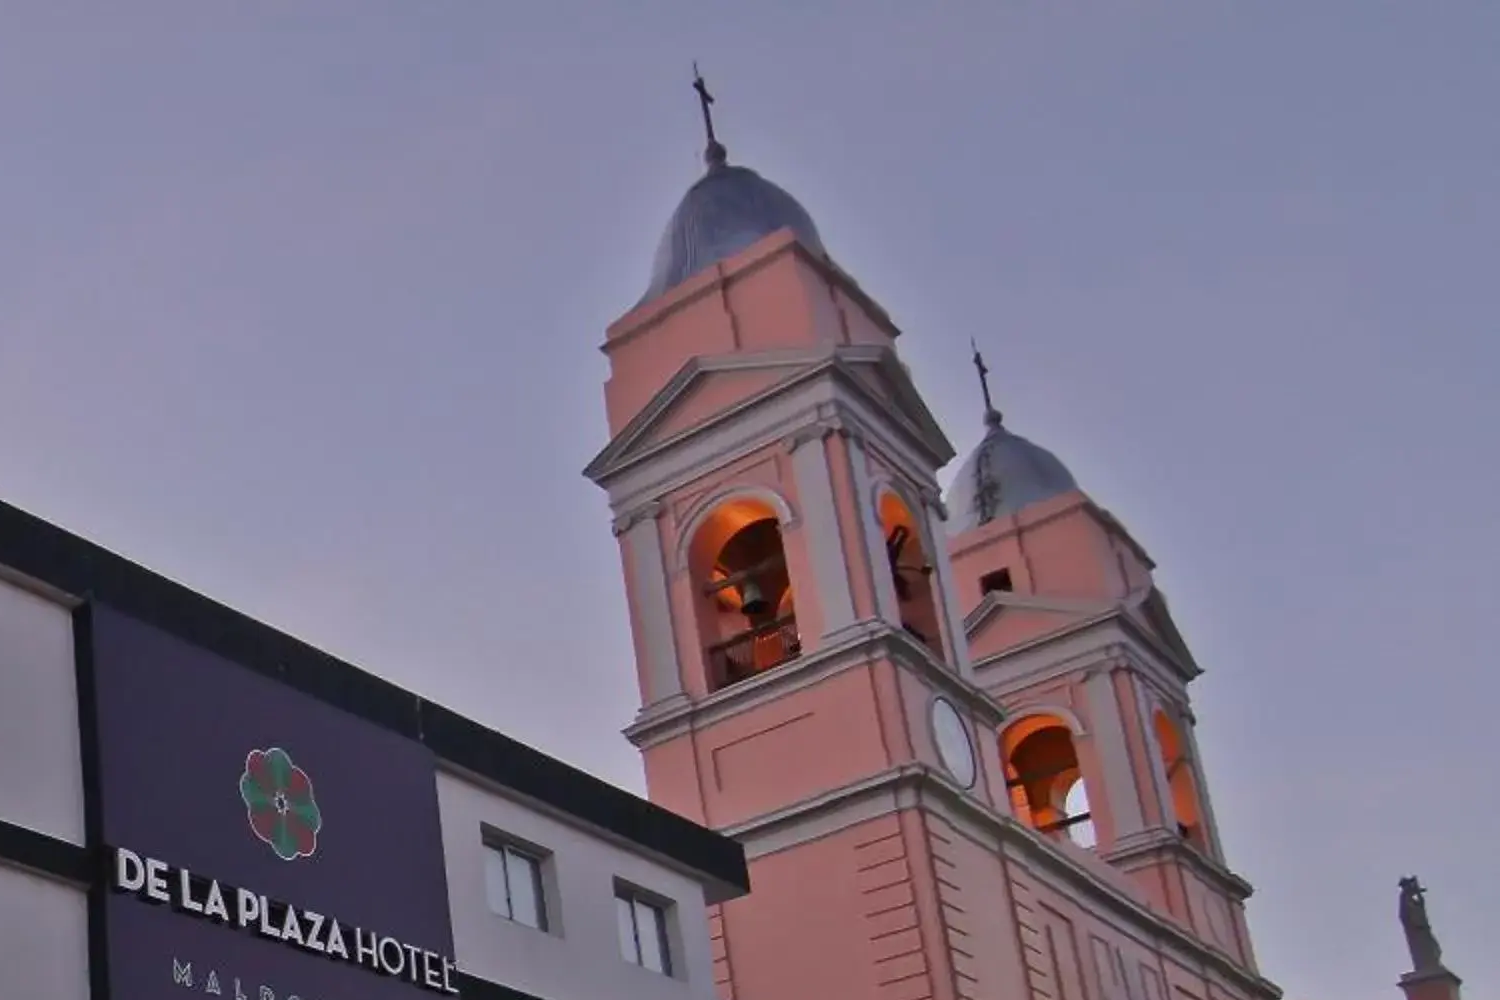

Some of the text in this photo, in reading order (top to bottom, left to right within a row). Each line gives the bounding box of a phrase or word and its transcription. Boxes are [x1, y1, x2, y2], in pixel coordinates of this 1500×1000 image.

[117, 848, 460, 993] DE LA PLAZA HOTEL
